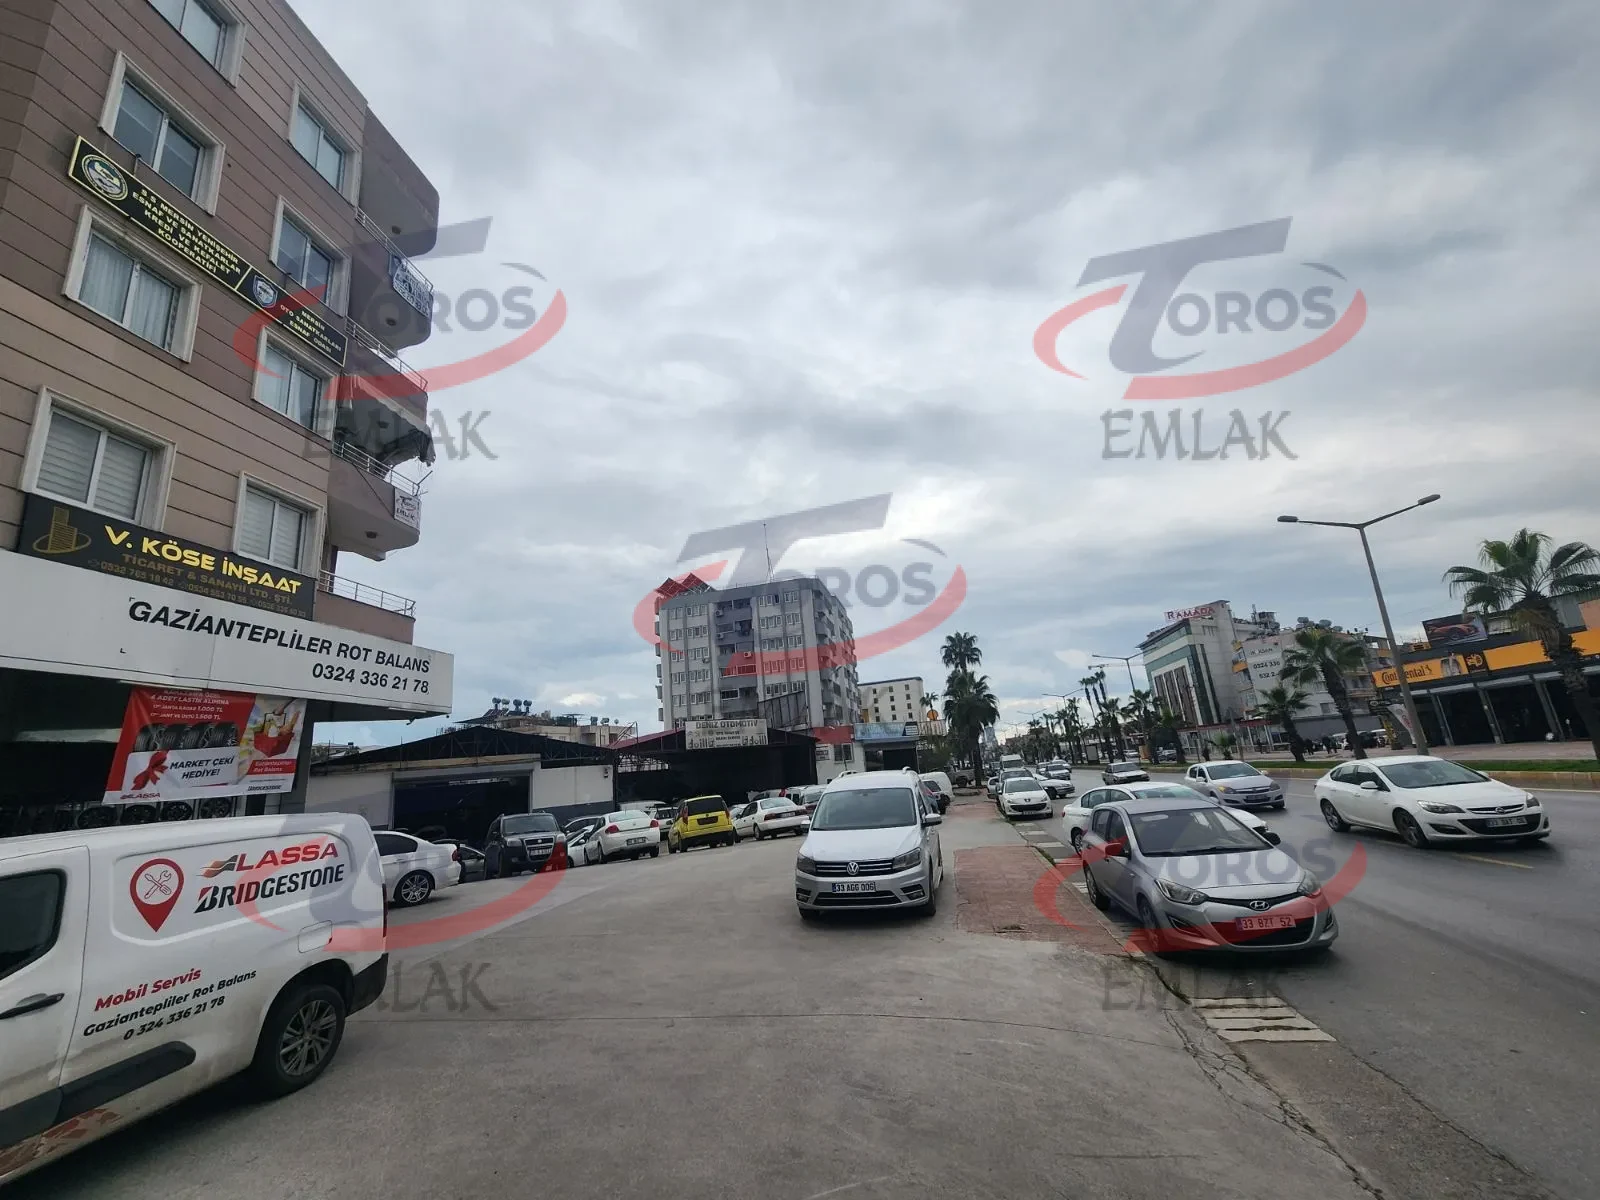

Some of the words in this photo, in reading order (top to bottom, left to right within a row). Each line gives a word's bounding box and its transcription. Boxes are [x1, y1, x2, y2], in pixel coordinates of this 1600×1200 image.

[132, 191, 164, 217] ESNAF
[166, 214, 178, 228] VE
[181, 223, 241, 274] SANATKARLAR
[144, 209, 173, 235] KREDİ
[179, 232, 191, 246] VE
[194, 244, 230, 275] KEFALET
[158, 228, 217, 273] KOOPERATİFİ
[160, 202, 194, 231] MERSİN
[197, 229, 239, 264] YENİŞEHİR
[280, 304, 294, 317] OTO
[104, 525, 133, 549] V.
[141, 537, 216, 571] KÖSE
[222, 557, 302, 594] İNŞAAT
[122, 553, 184, 577] TİCARET
[187, 571, 196, 580] &
[1167, 607, 1215, 619] RAMADA
[129, 601, 333, 655] GAZİANTEPLİLER
[336, 642, 373, 663] ROT
[375, 652, 430, 673] BALANS
[312, 662, 355, 683] 0324
[359, 670, 388, 687] 336
[392, 676, 408, 691] 21
[414, 679, 429, 694] 78
[1381, 664, 1426, 684] Contental
[170, 758, 211, 770] MARKET
[213, 755, 235, 767] ÇEKİ
[182, 767, 221, 780] HEDİYE!
[235, 842, 339, 872] LASSA
[193, 863, 345, 914] BRIDGESTONE
[1242, 919, 1253, 928] 33
[1280, 917, 1291, 926] 52
[83, 993, 190, 1037] Gaziantepliler
[191, 984, 214, 999] Rot
[217, 969, 257, 990] Balans
[94, 983, 148, 1012] Mobil
[151, 967, 201, 994] Servis
[123, 1028, 135, 1041] 0
[137, 1017, 164, 1036] 324
[167, 1007, 193, 1025] 336
[194, 1002, 208, 1015] 21
[210, 995, 225, 1009] 78
